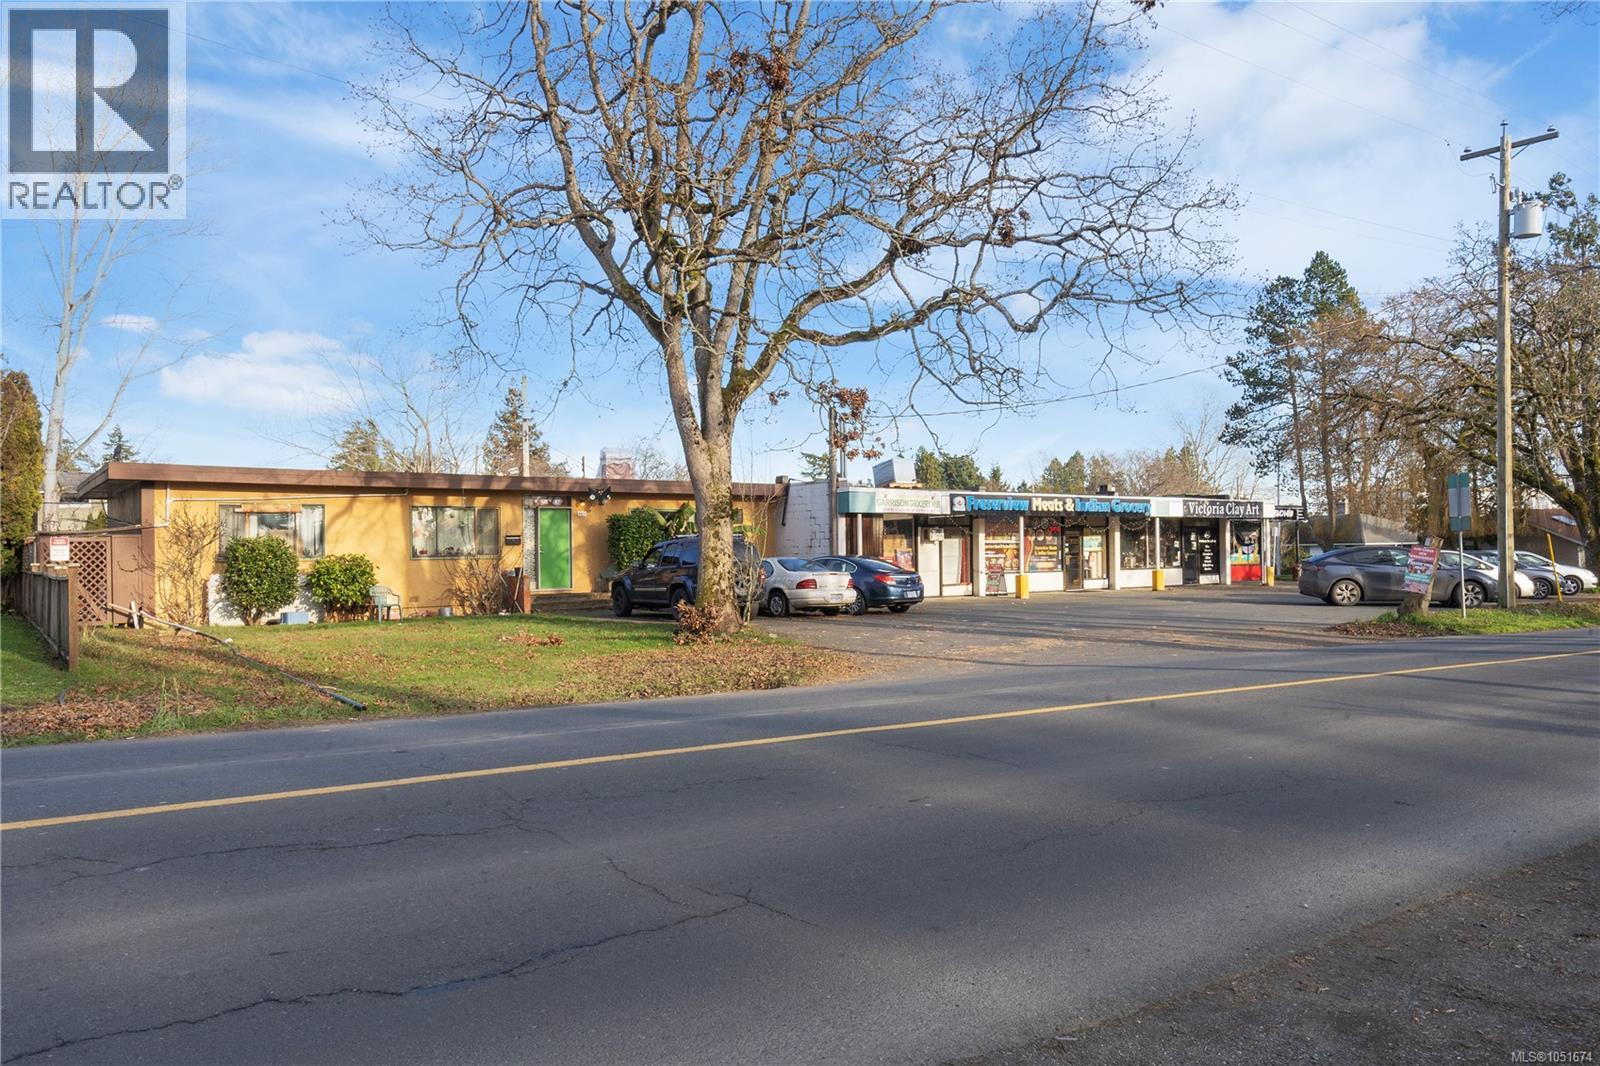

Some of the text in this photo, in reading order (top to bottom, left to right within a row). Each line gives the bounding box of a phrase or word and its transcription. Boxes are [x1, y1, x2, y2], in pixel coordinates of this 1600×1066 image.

[1031, 497, 1063, 511] Meats
[1064, 498, 1075, 512] &
[1075, 498, 1110, 512] Indian
[1111, 498, 1151, 516] Grocery
[1189, 501, 1224, 516] Victoria
[1226, 502, 1244, 517] Clay
[1246, 503, 1260, 515] Art
